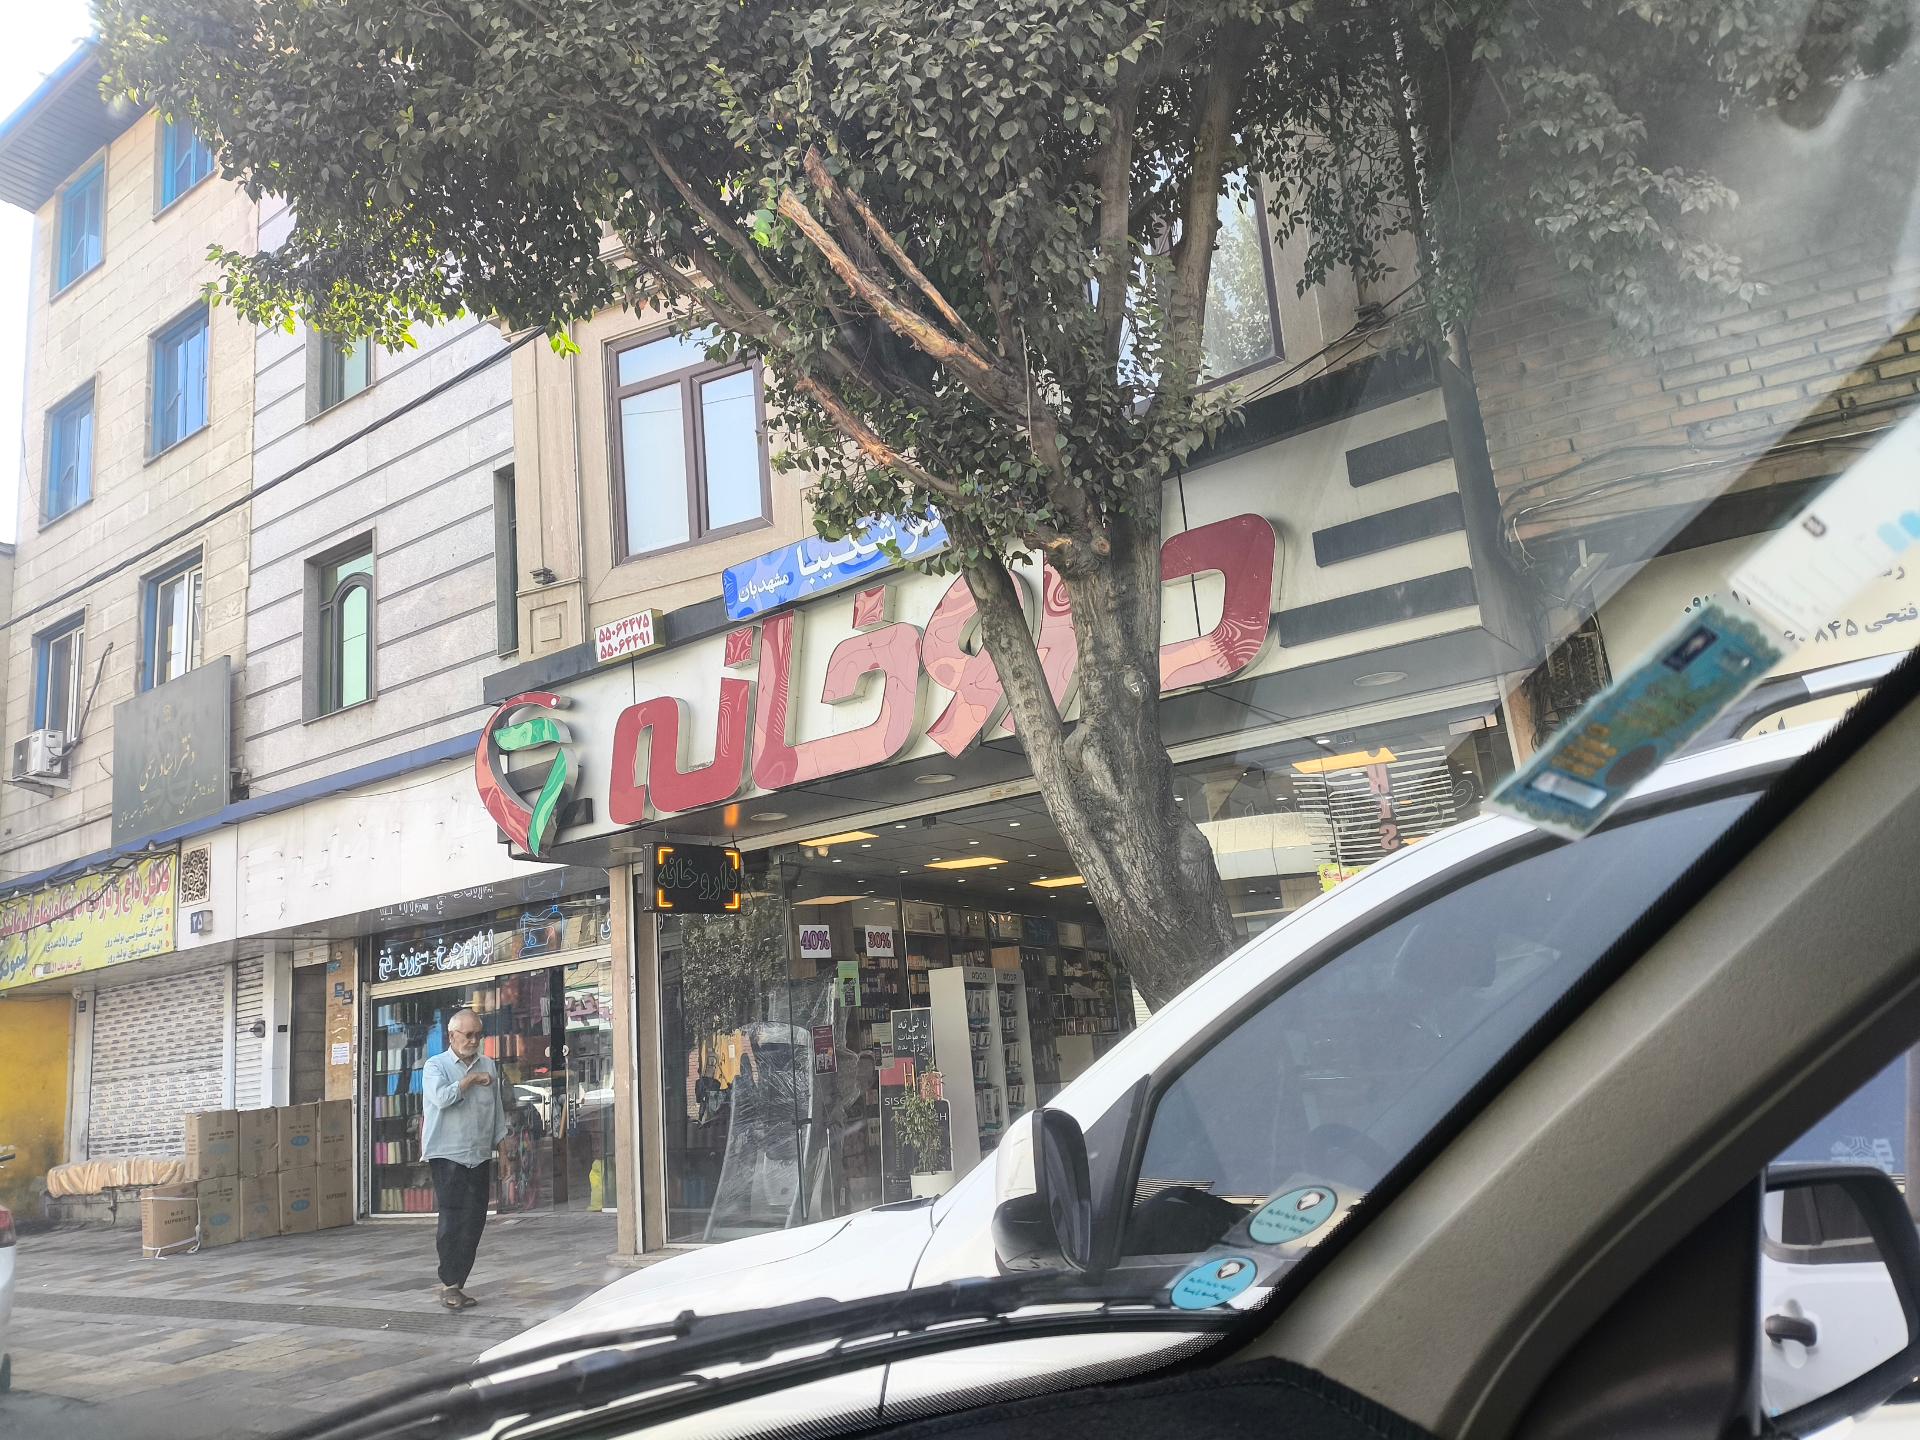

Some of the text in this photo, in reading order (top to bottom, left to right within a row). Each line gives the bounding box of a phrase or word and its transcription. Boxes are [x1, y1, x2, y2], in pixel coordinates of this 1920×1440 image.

[738, 571, 789, 603] مشهدبان
[599, 614, 649, 642] ۵۵۰۶۴۴۷۵
[601, 631, 650, 659] ۵۵۰۶۴۴۹۱
[658, 857, 737, 900] داروخانه
[192, 914, 203, 930] ۲۵
[436, 938, 464, 971] چرخ
[464, 929, 494, 966] لوازم
[801, 930, 830, 950] 40%
[867, 931, 891, 949] 30%
[399, 947, 429, 977] سوزن
